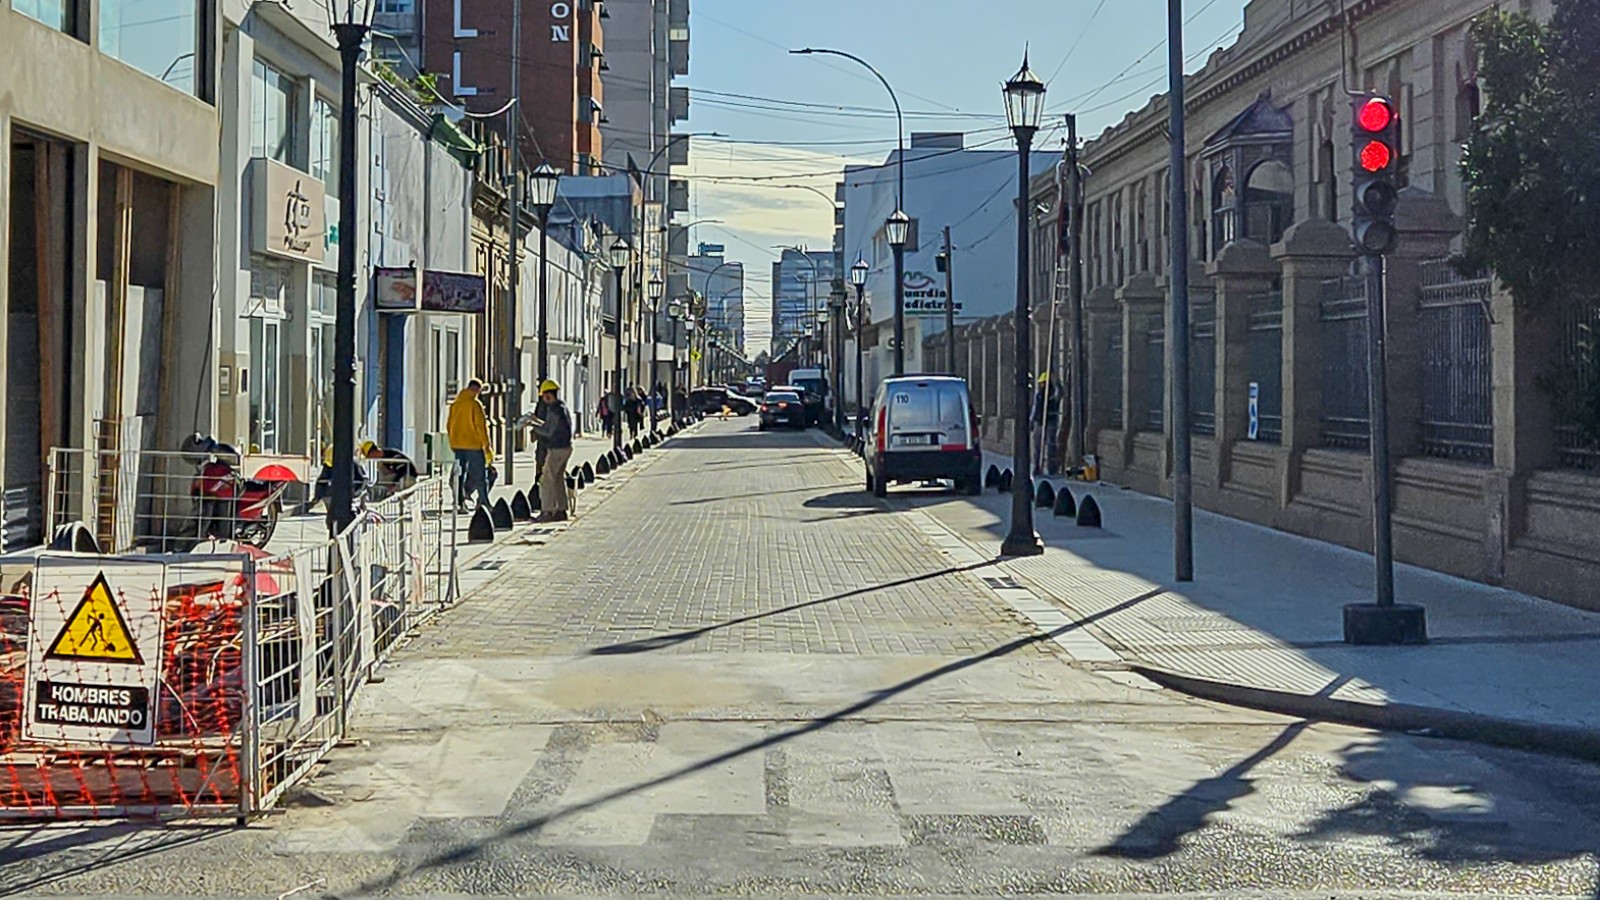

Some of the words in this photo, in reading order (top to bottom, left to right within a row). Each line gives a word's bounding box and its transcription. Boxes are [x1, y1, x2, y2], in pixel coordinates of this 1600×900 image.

[904, 288, 946, 298] uardia
[895, 394, 910, 404] 110
[51, 685, 131, 706] HOMBRES
[38, 703, 143, 725] TRABAJANDO
